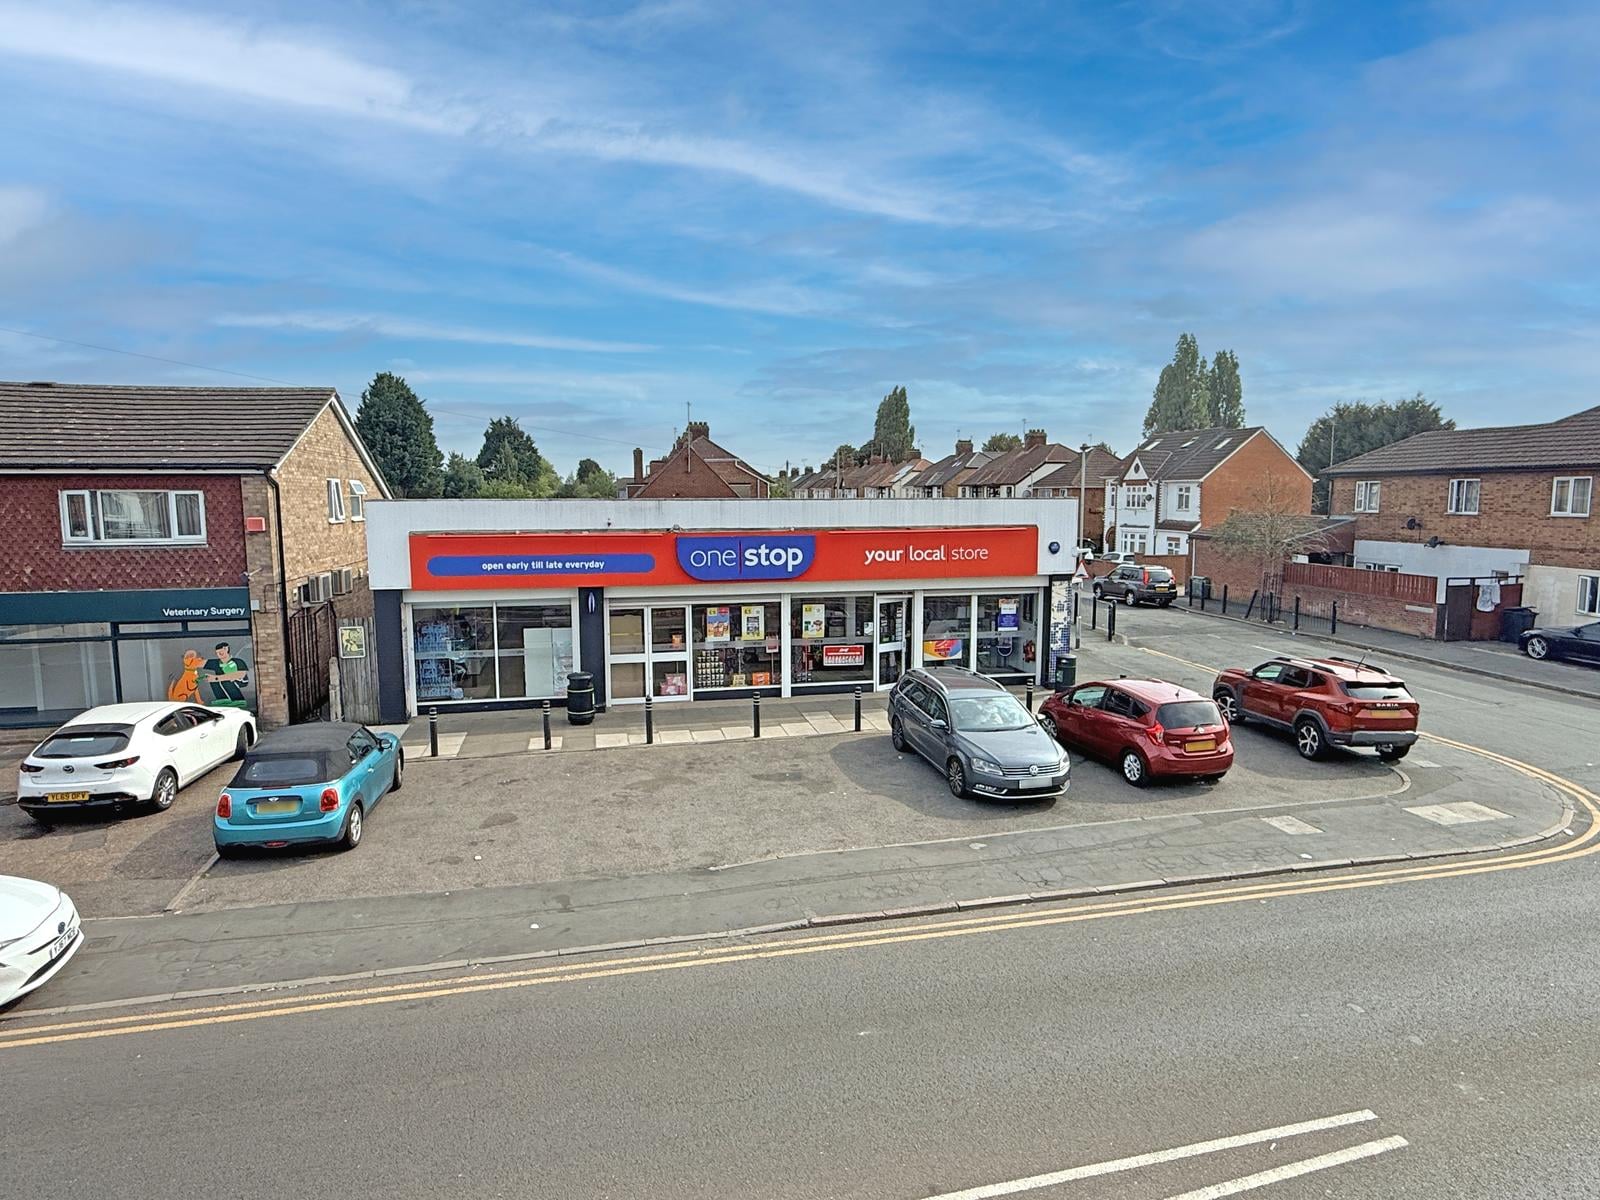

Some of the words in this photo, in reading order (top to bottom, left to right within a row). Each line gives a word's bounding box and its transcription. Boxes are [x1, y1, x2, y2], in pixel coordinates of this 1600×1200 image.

[690, 550, 737, 568] one
[744, 544, 804, 572] stop
[864, 548, 904, 566] your
[909, 545, 946, 562] local
[951, 547, 989, 561] store
[482, 562, 504, 571] open
[506, 561, 529, 571] early
[531, 560, 544, 569] till
[546, 560, 563, 569] late
[565, 560, 605, 570] everyday
[162, 608, 209, 616] Veterinary
[210, 607, 245, 616] Surgery
